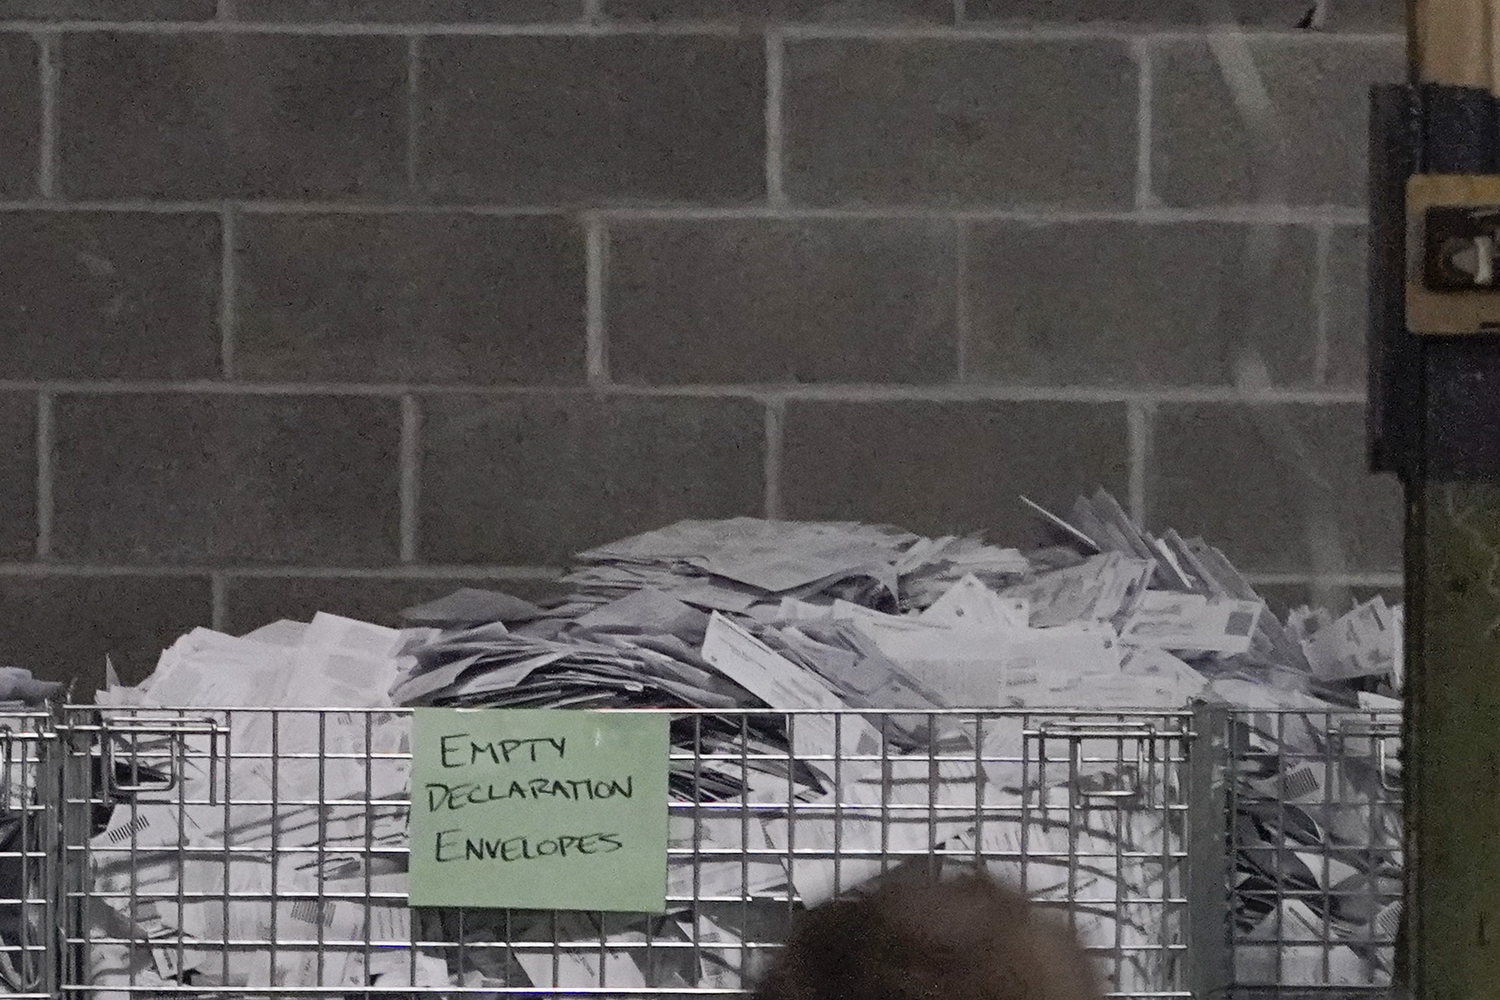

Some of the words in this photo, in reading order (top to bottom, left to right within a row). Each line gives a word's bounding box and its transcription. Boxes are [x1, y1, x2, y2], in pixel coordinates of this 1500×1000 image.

[440, 733, 566, 768] EMPTY
[425, 775, 633, 812] DECLARATION
[435, 828, 623, 863] ENVELOPES
